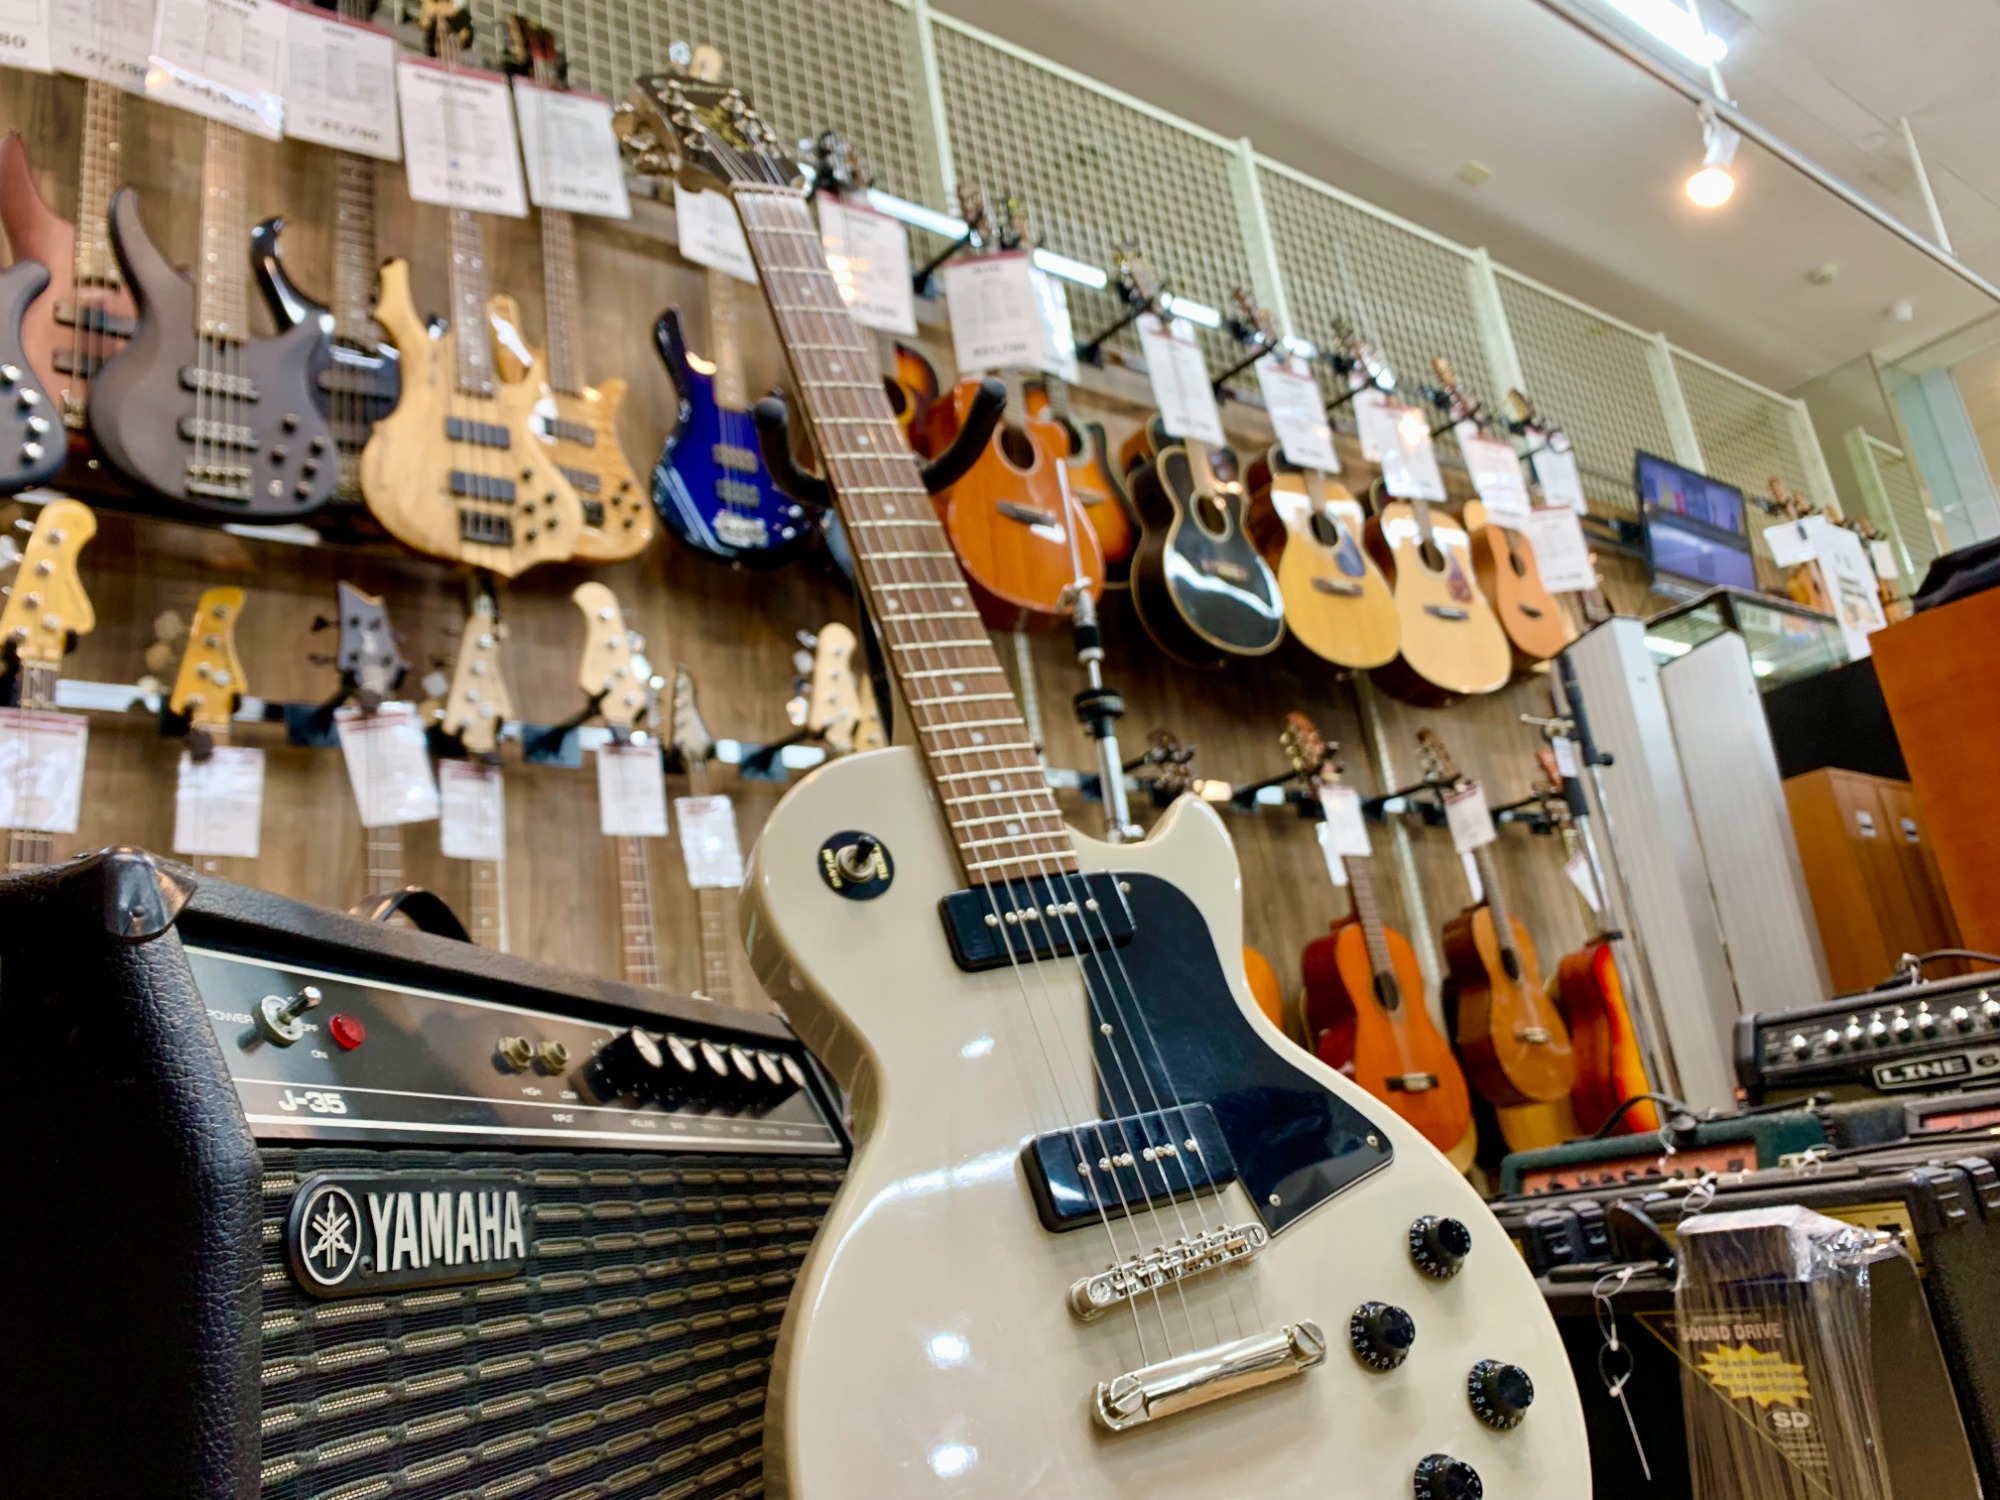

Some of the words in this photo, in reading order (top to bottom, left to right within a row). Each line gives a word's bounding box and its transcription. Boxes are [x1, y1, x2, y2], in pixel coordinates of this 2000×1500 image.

[1880, 1056, 1967, 1084] LINE
[278, 1089, 348, 1115] J-35
[365, 1190, 526, 1273] YAMAHA
[1680, 1324, 1731, 1342] SOUND
[1733, 1322, 1783, 1340] DRIVE
[1772, 1411, 1811, 1429] SD
